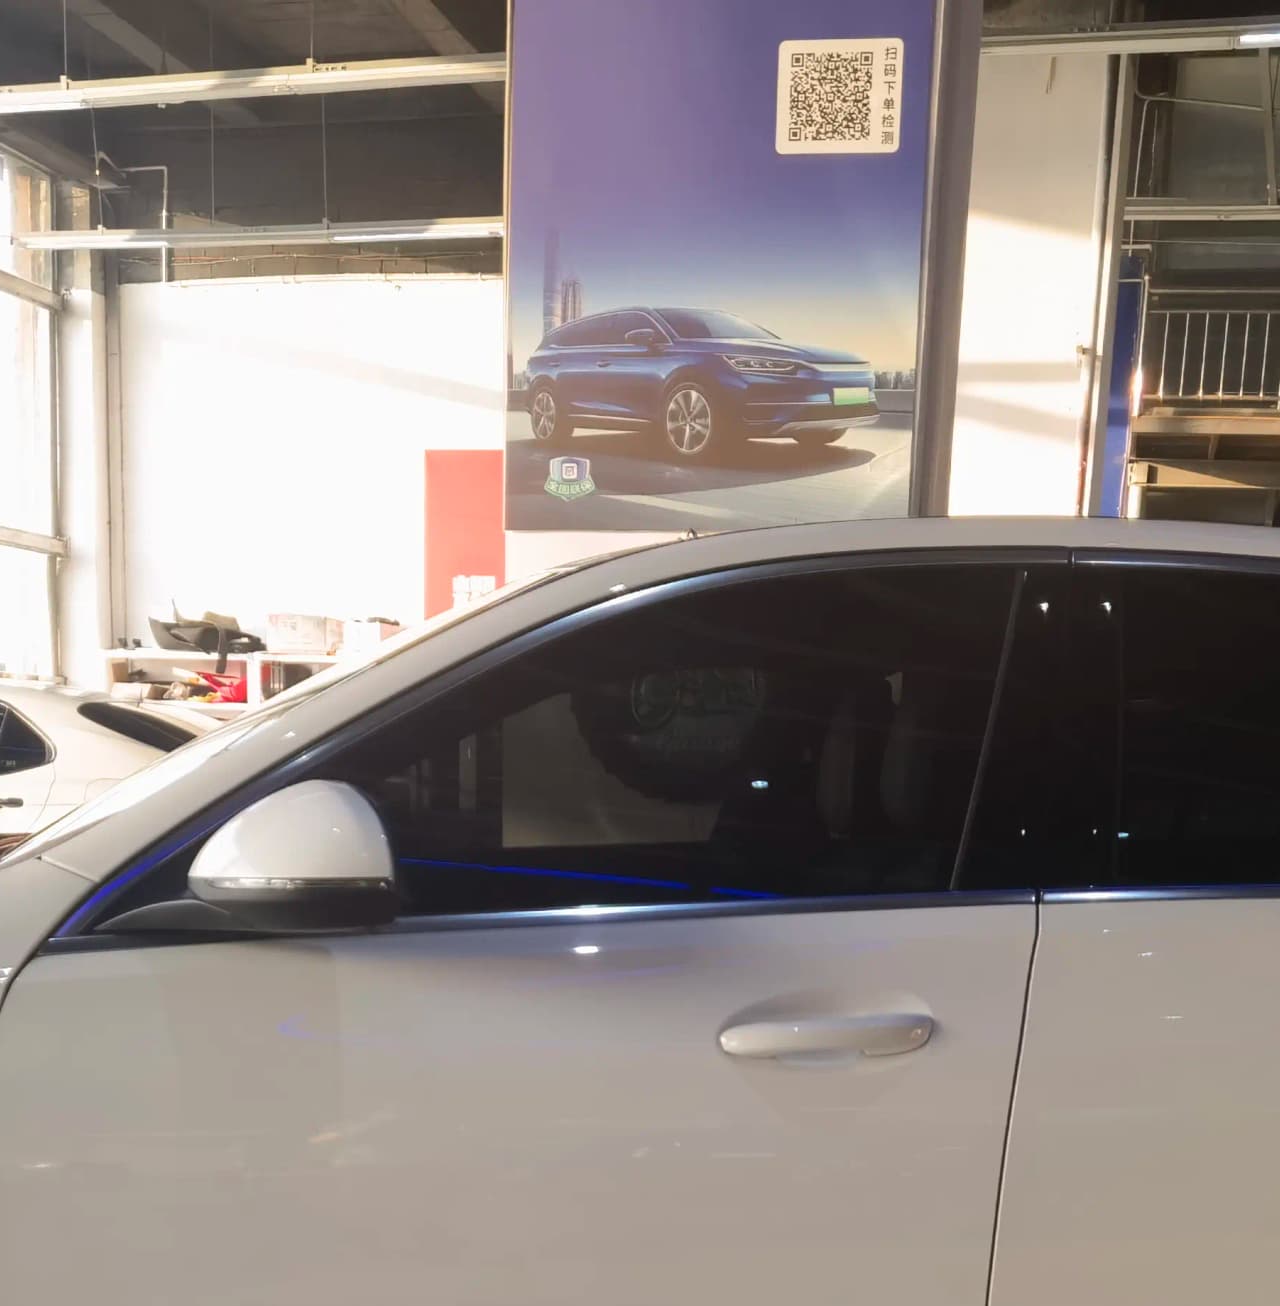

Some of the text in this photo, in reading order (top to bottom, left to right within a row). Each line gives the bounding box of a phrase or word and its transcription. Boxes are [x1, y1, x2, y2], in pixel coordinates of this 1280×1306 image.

[881, 46, 898, 145] 扫码下单检测
